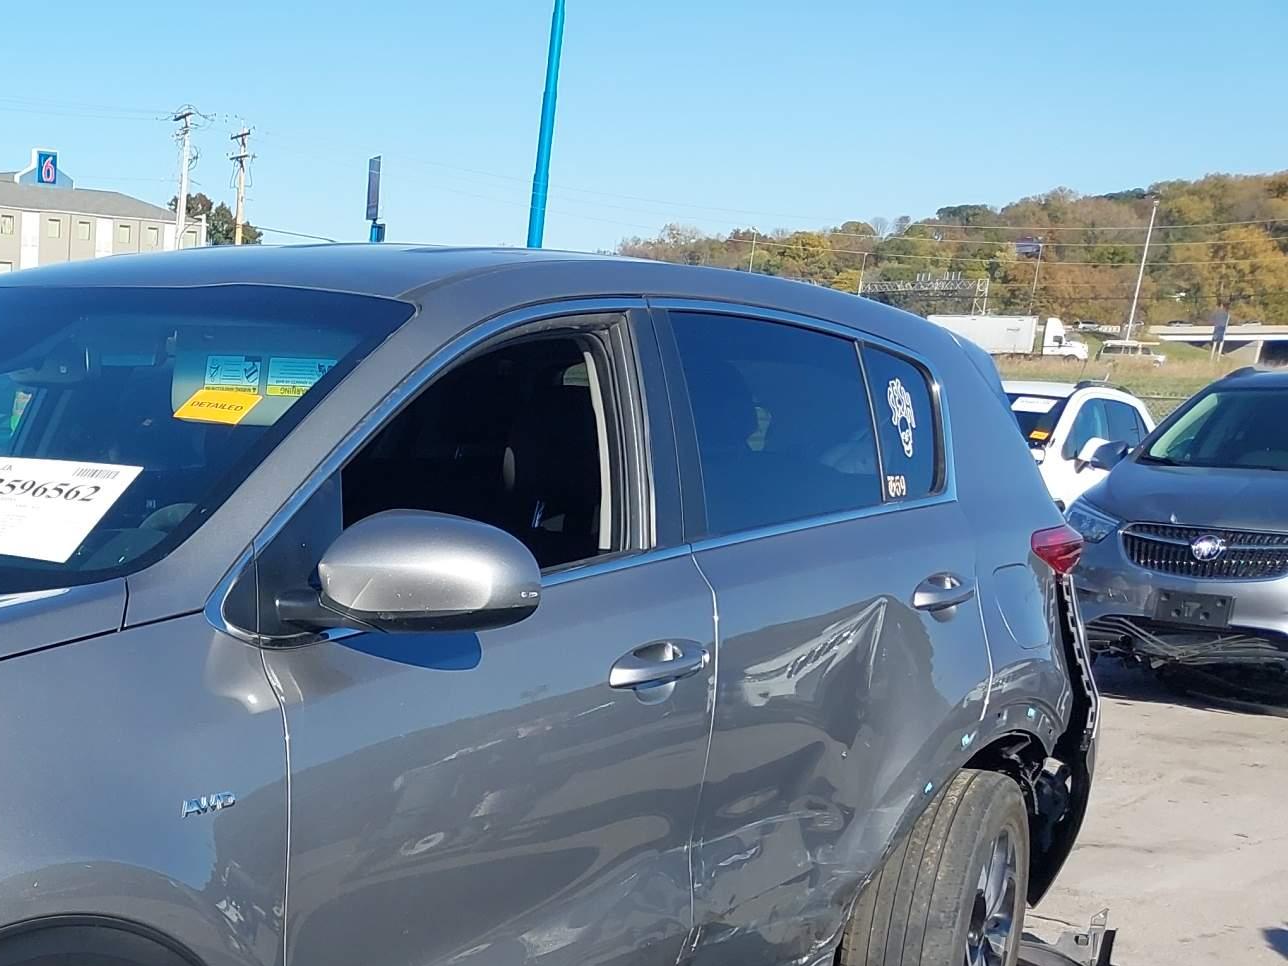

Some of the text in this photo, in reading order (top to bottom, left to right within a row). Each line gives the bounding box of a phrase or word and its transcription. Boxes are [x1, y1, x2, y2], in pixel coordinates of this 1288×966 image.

[42, 156, 55, 183] 6
[190, 400, 244, 412] DETAILED
[182, 792, 236, 817] AWD
